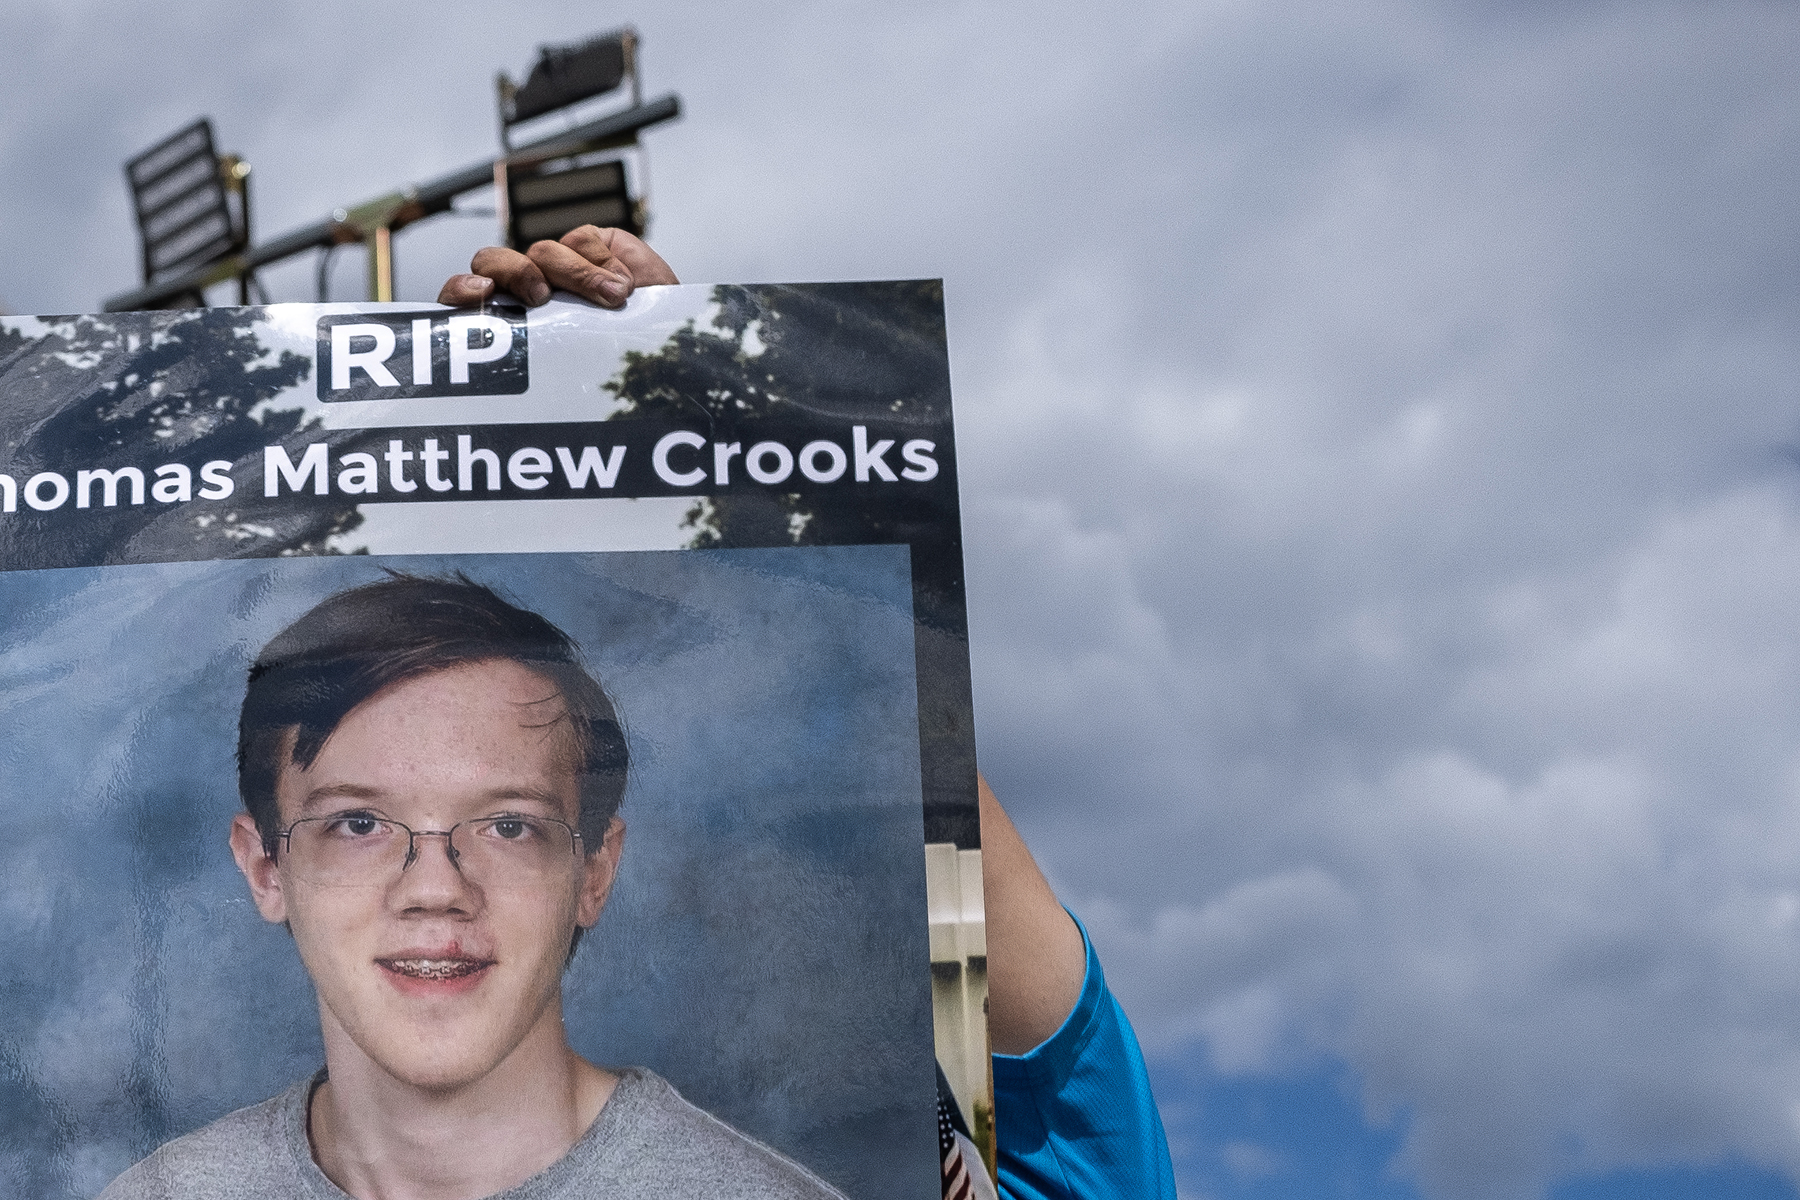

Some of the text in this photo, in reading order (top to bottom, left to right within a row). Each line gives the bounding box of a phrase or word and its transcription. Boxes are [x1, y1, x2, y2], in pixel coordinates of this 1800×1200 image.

[330, 314, 514, 390] RIP
[263, 434, 628, 498] Matthew
[651, 425, 940, 487] Crooks
